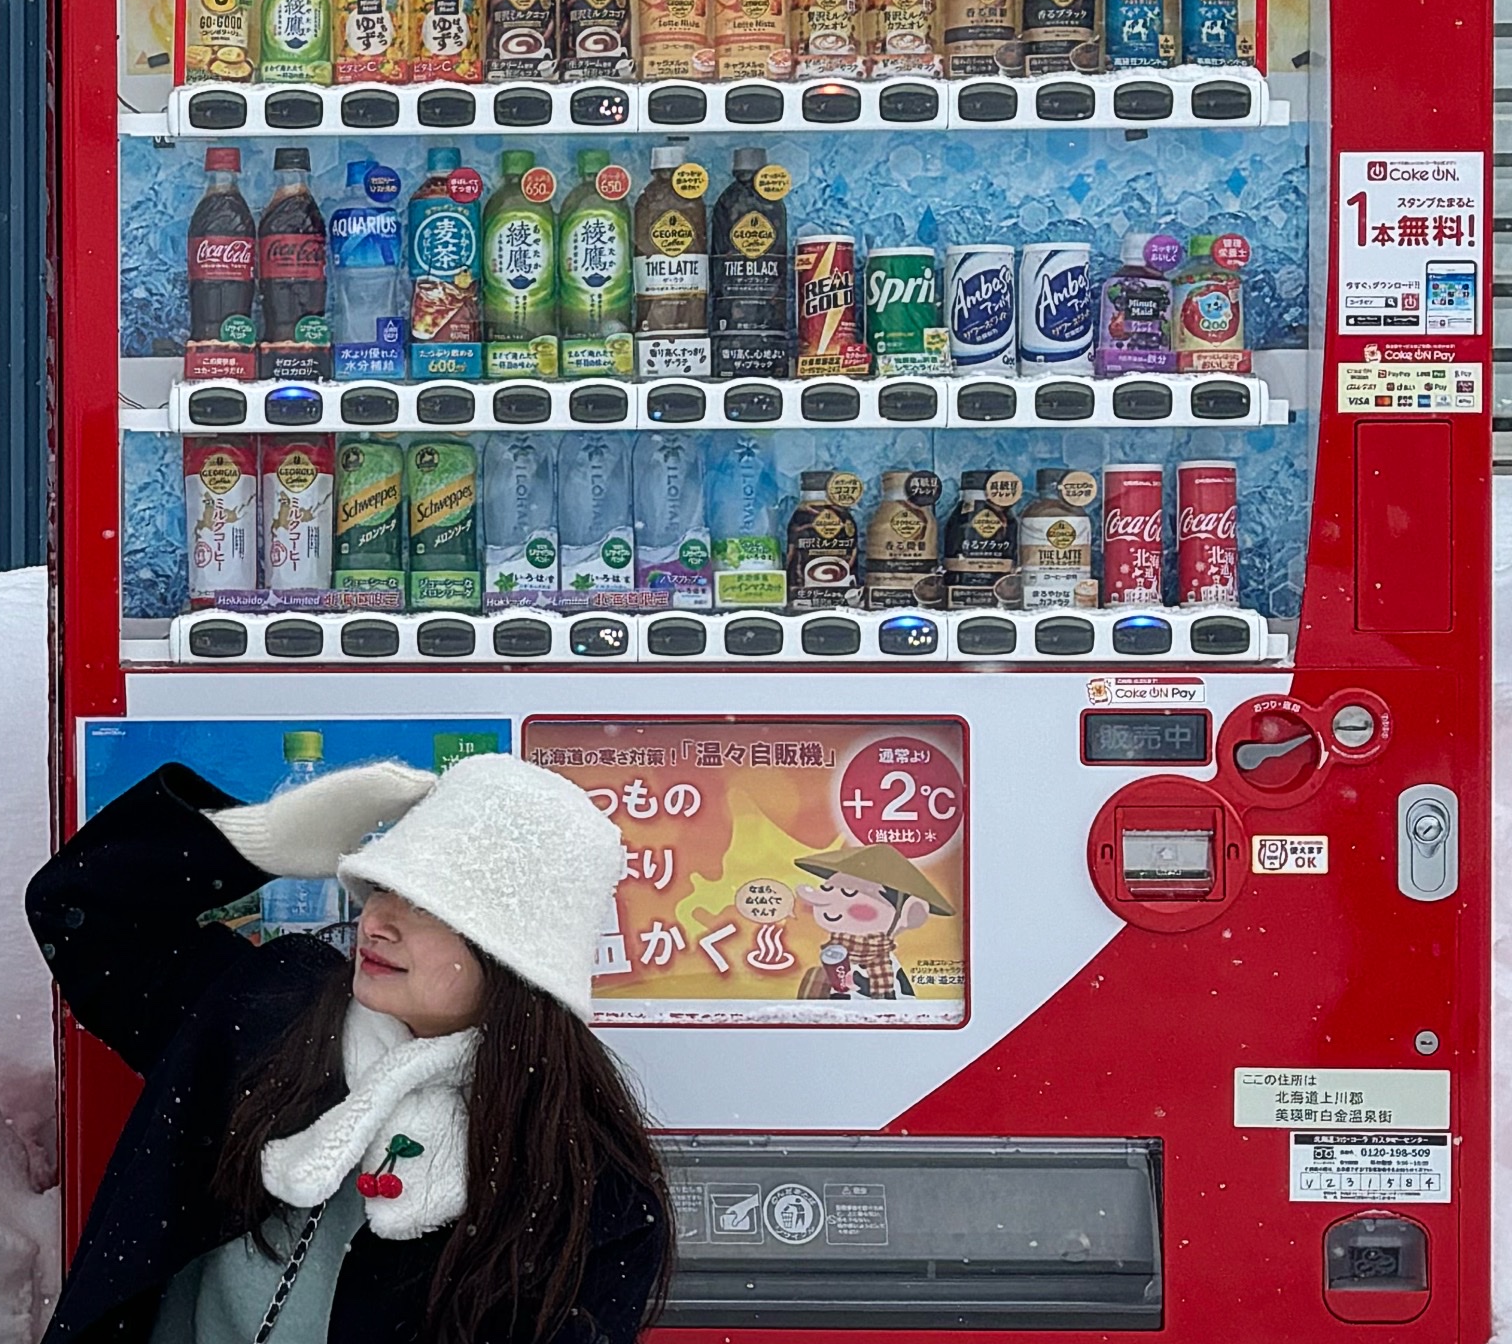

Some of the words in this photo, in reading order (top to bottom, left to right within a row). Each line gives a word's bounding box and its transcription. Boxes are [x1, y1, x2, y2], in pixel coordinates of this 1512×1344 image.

[356, 17, 375, 51] ゆず
[432, 16, 452, 52] ゆず
[1389, 168, 1429, 181] Coke
[1397, 197, 1475, 208] スタンプたまると
[332, 215, 397, 237] AQUARIUS
[1346, 191, 1475, 247] 1本無料!
[196, 239, 252, 264] Coca-Cola
[434, 219, 460, 269] 麦茶
[505, 220, 534, 274] 綾鷹
[581, 218, 608, 273] 綾鷹
[645, 260, 666, 276] THE
[668, 260, 699, 276] LATTE
[725, 260, 745, 276] THE
[746, 260, 779, 276] BLACK
[804, 267, 854, 299] REAL
[804, 289, 854, 318] GOLD
[341, 484, 398, 523] Schweppes
[416, 484, 473, 524] Schweppes
[213, 497, 227, 572] ミルクコーヒー
[289, 497, 303, 572] ミルクコーヒー
[962, 540, 1010, 550] 香るブラック
[1038, 550, 1054, 561] THE
[1056, 550, 1082, 560] LATTE
[218, 595, 262, 605] Hokkaido
[283, 594, 320, 605] Limited
[1115, 688, 1147, 698] Coke
[1149, 687, 1169, 698] ON
[1172, 688, 1196, 700] Pay
[1100, 724, 1191, 750] 販売中
[879, 748, 930, 764] 通常より
[1295, 856, 1317, 868] OK
[750, 907, 777, 917] やんす
[1242, 1073, 1318, 1087] ここの住所は
[1275, 1090, 1365, 1106] 北海道上川郡
[1275, 1108, 1393, 1124] 美瑛町白金温泉街
[1360, 1147, 1431, 1158] 0120-198-509
